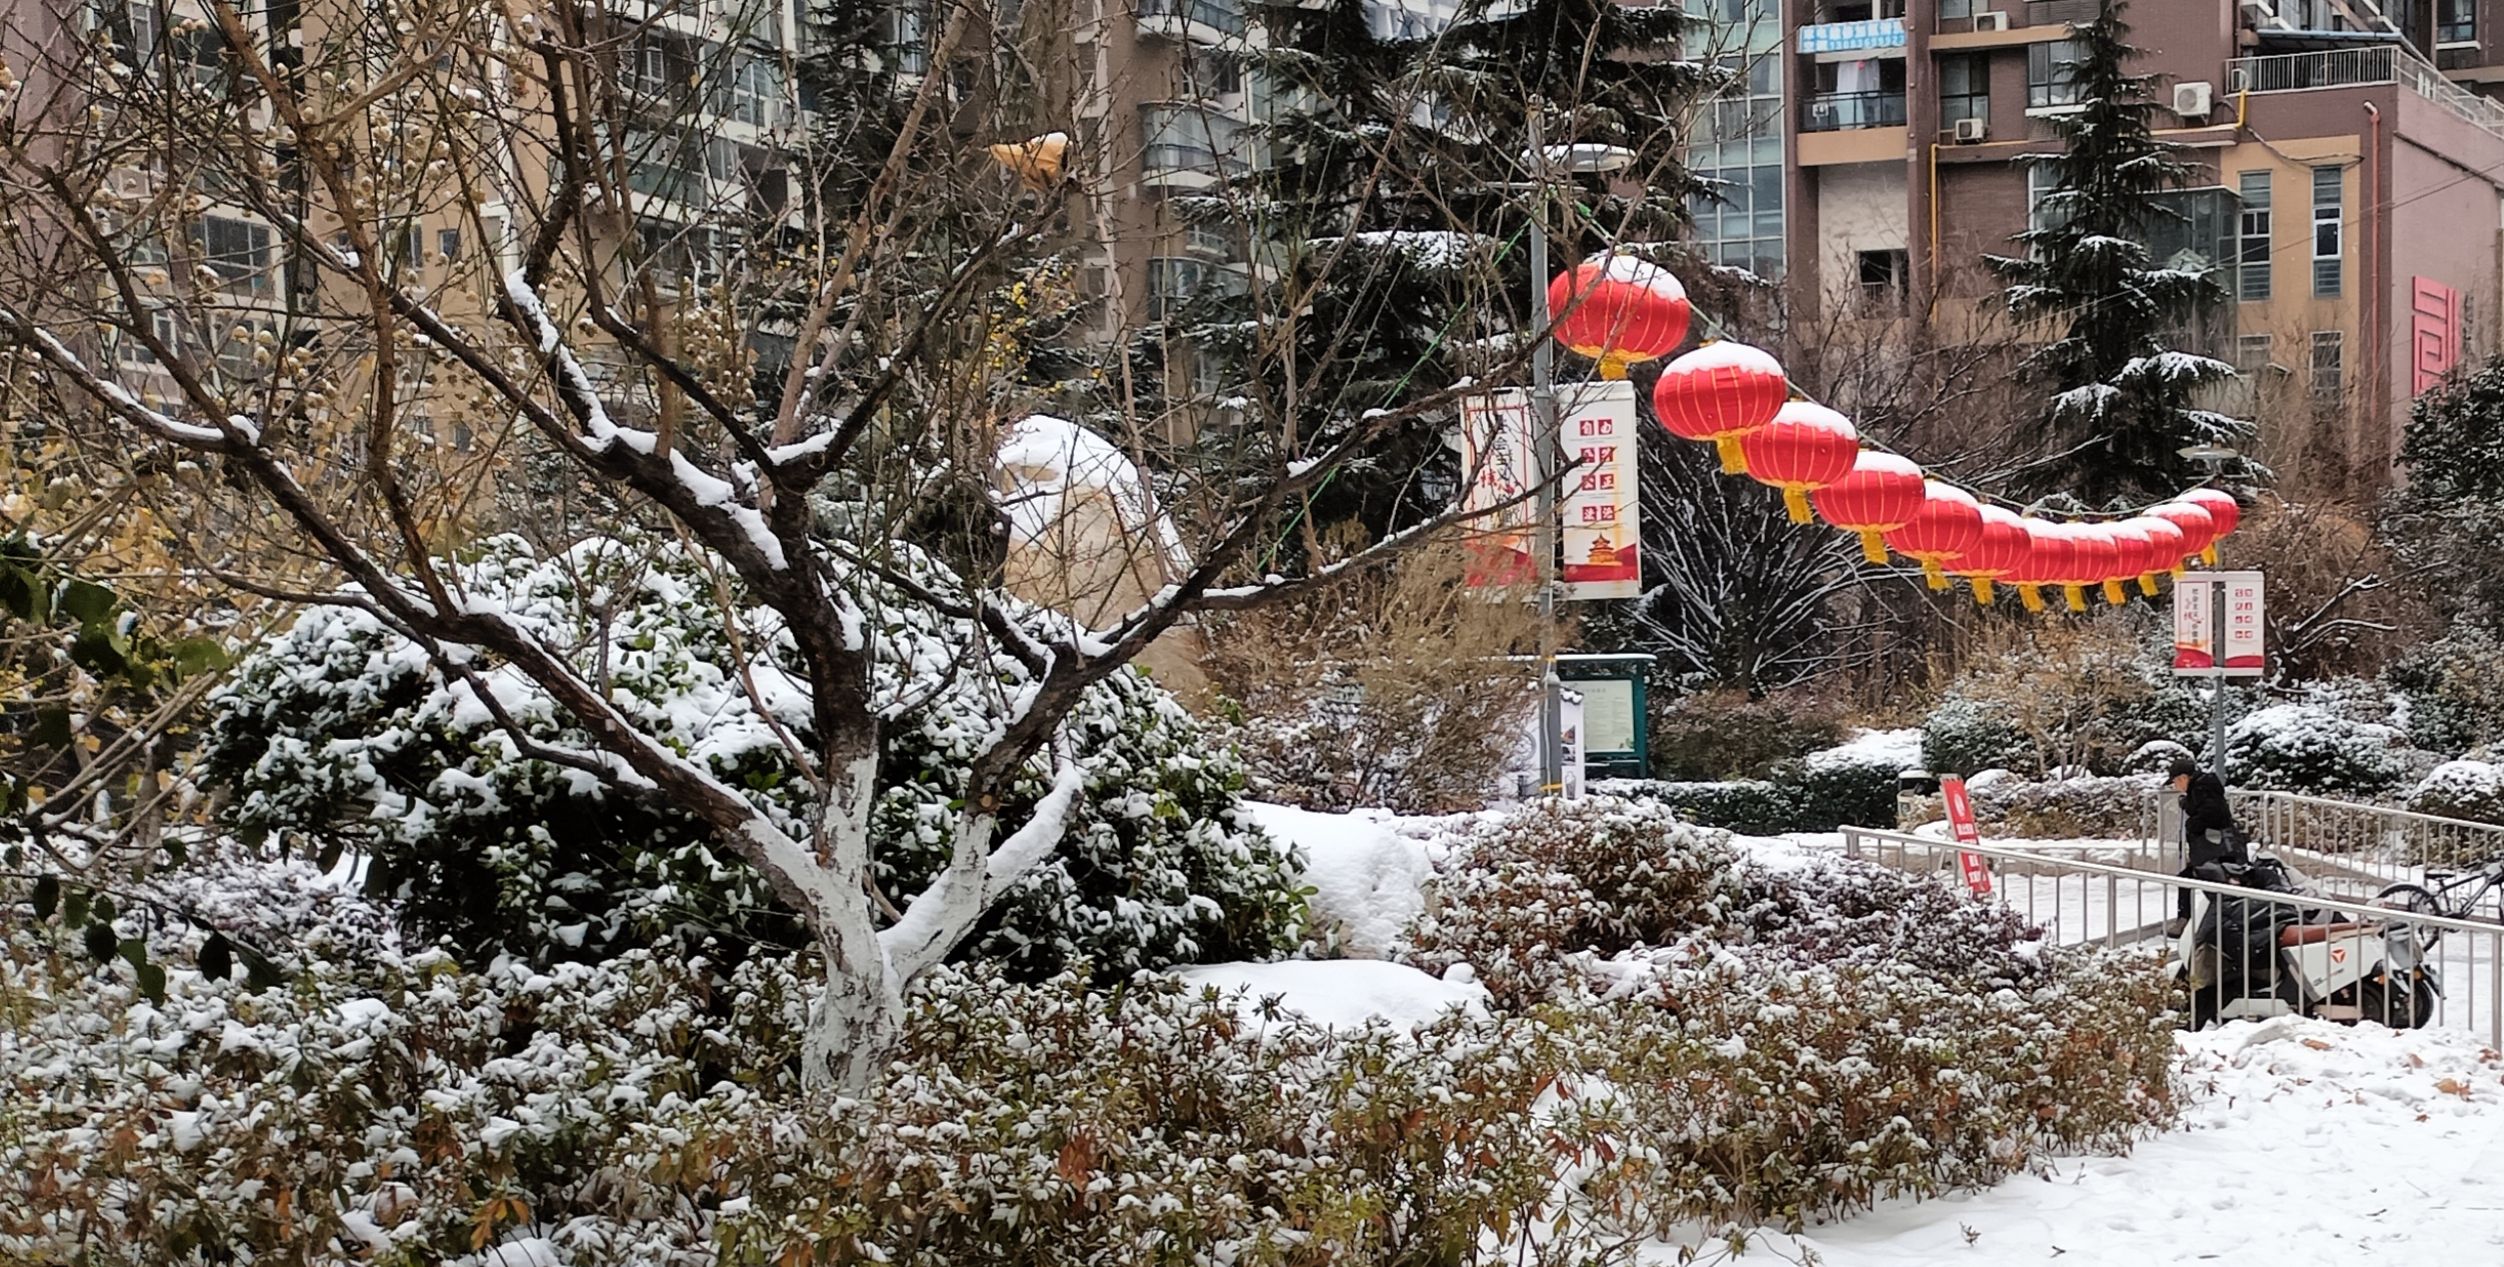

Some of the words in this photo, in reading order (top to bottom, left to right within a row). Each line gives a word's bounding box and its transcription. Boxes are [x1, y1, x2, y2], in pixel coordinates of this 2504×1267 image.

[1580, 420, 1612, 435] 自由
[1582, 474, 1615, 491] 公正
[1583, 505, 1615, 522] 法治
